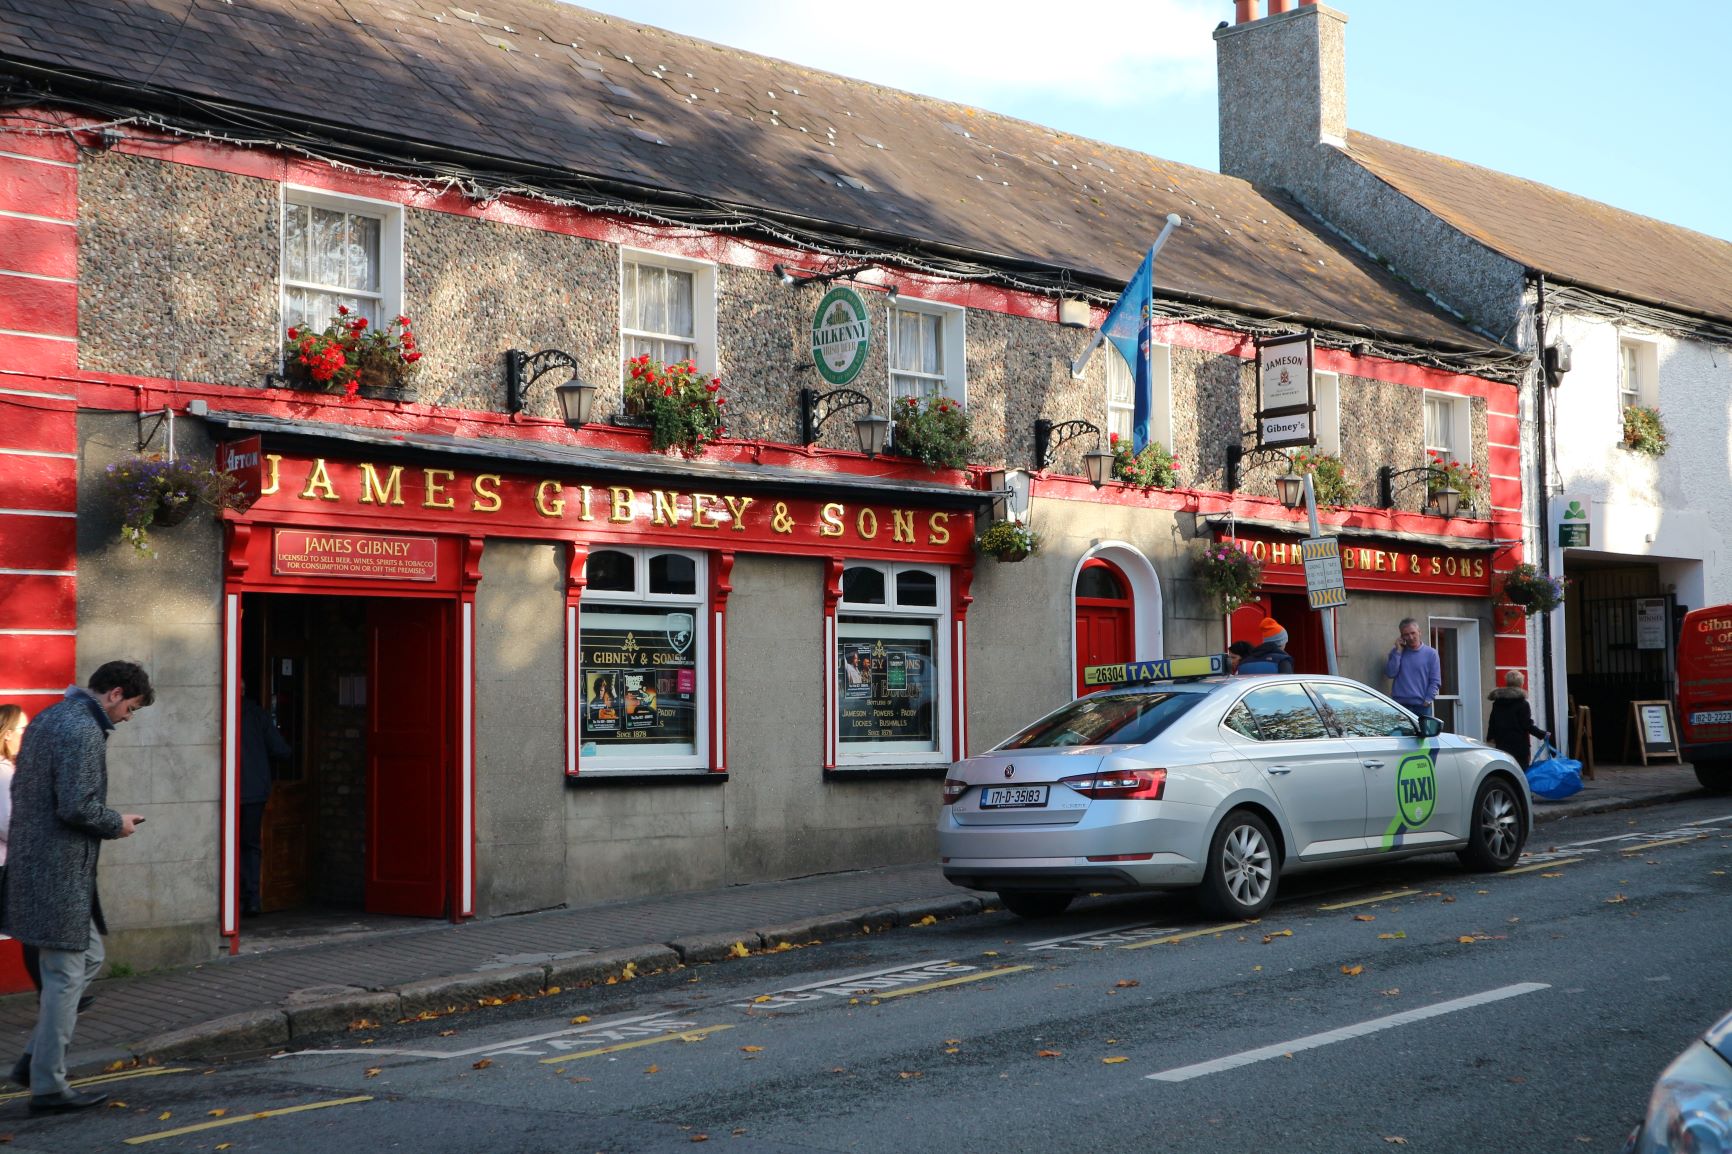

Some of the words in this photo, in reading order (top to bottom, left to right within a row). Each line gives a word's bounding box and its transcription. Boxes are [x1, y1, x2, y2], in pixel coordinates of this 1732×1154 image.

[813, 321, 867, 346] KILKENNY
[1265, 356, 1303, 372] JAMESON
[1266, 422, 1305, 434] Gibney's
[226, 448, 258, 471] AFTON
[261, 454, 502, 512] JAMES
[535, 479, 752, 531] GIBNEY
[771, 501, 794, 534] &
[820, 502, 950, 545] SONS
[305, 537, 351, 554] JAMES
[357, 540, 411, 556] GIBNEY
[278, 553, 309, 562] LICENSED
[404, 560, 433, 568] TOBACCO
[301, 562, 349, 571] CONSUMPTION
[397, 567, 426, 575] PREMISES
[1343, 548, 1399, 572] BNEY
[1410, 554, 1420, 574] &
[1431, 556, 1484, 578] SONS
[593, 652, 637, 664] GIBNEY
[640, 653, 648, 665] &
[1095, 666, 1124, 682] 26304
[1129, 662, 1169, 681] TAXI
[1210, 657, 1221, 671] D
[657, 708, 676, 717] PADDY
[843, 708, 867, 717] JAMESON
[873, 709, 894, 717] POWERS
[901, 709, 917, 717] PADDY
[879, 719, 908, 727] BUSHMILLS
[991, 790, 1041, 804] 171-D-35183
[1400, 776, 1432, 804] TAXI
[482, 1019, 699, 1057] TAXIS
